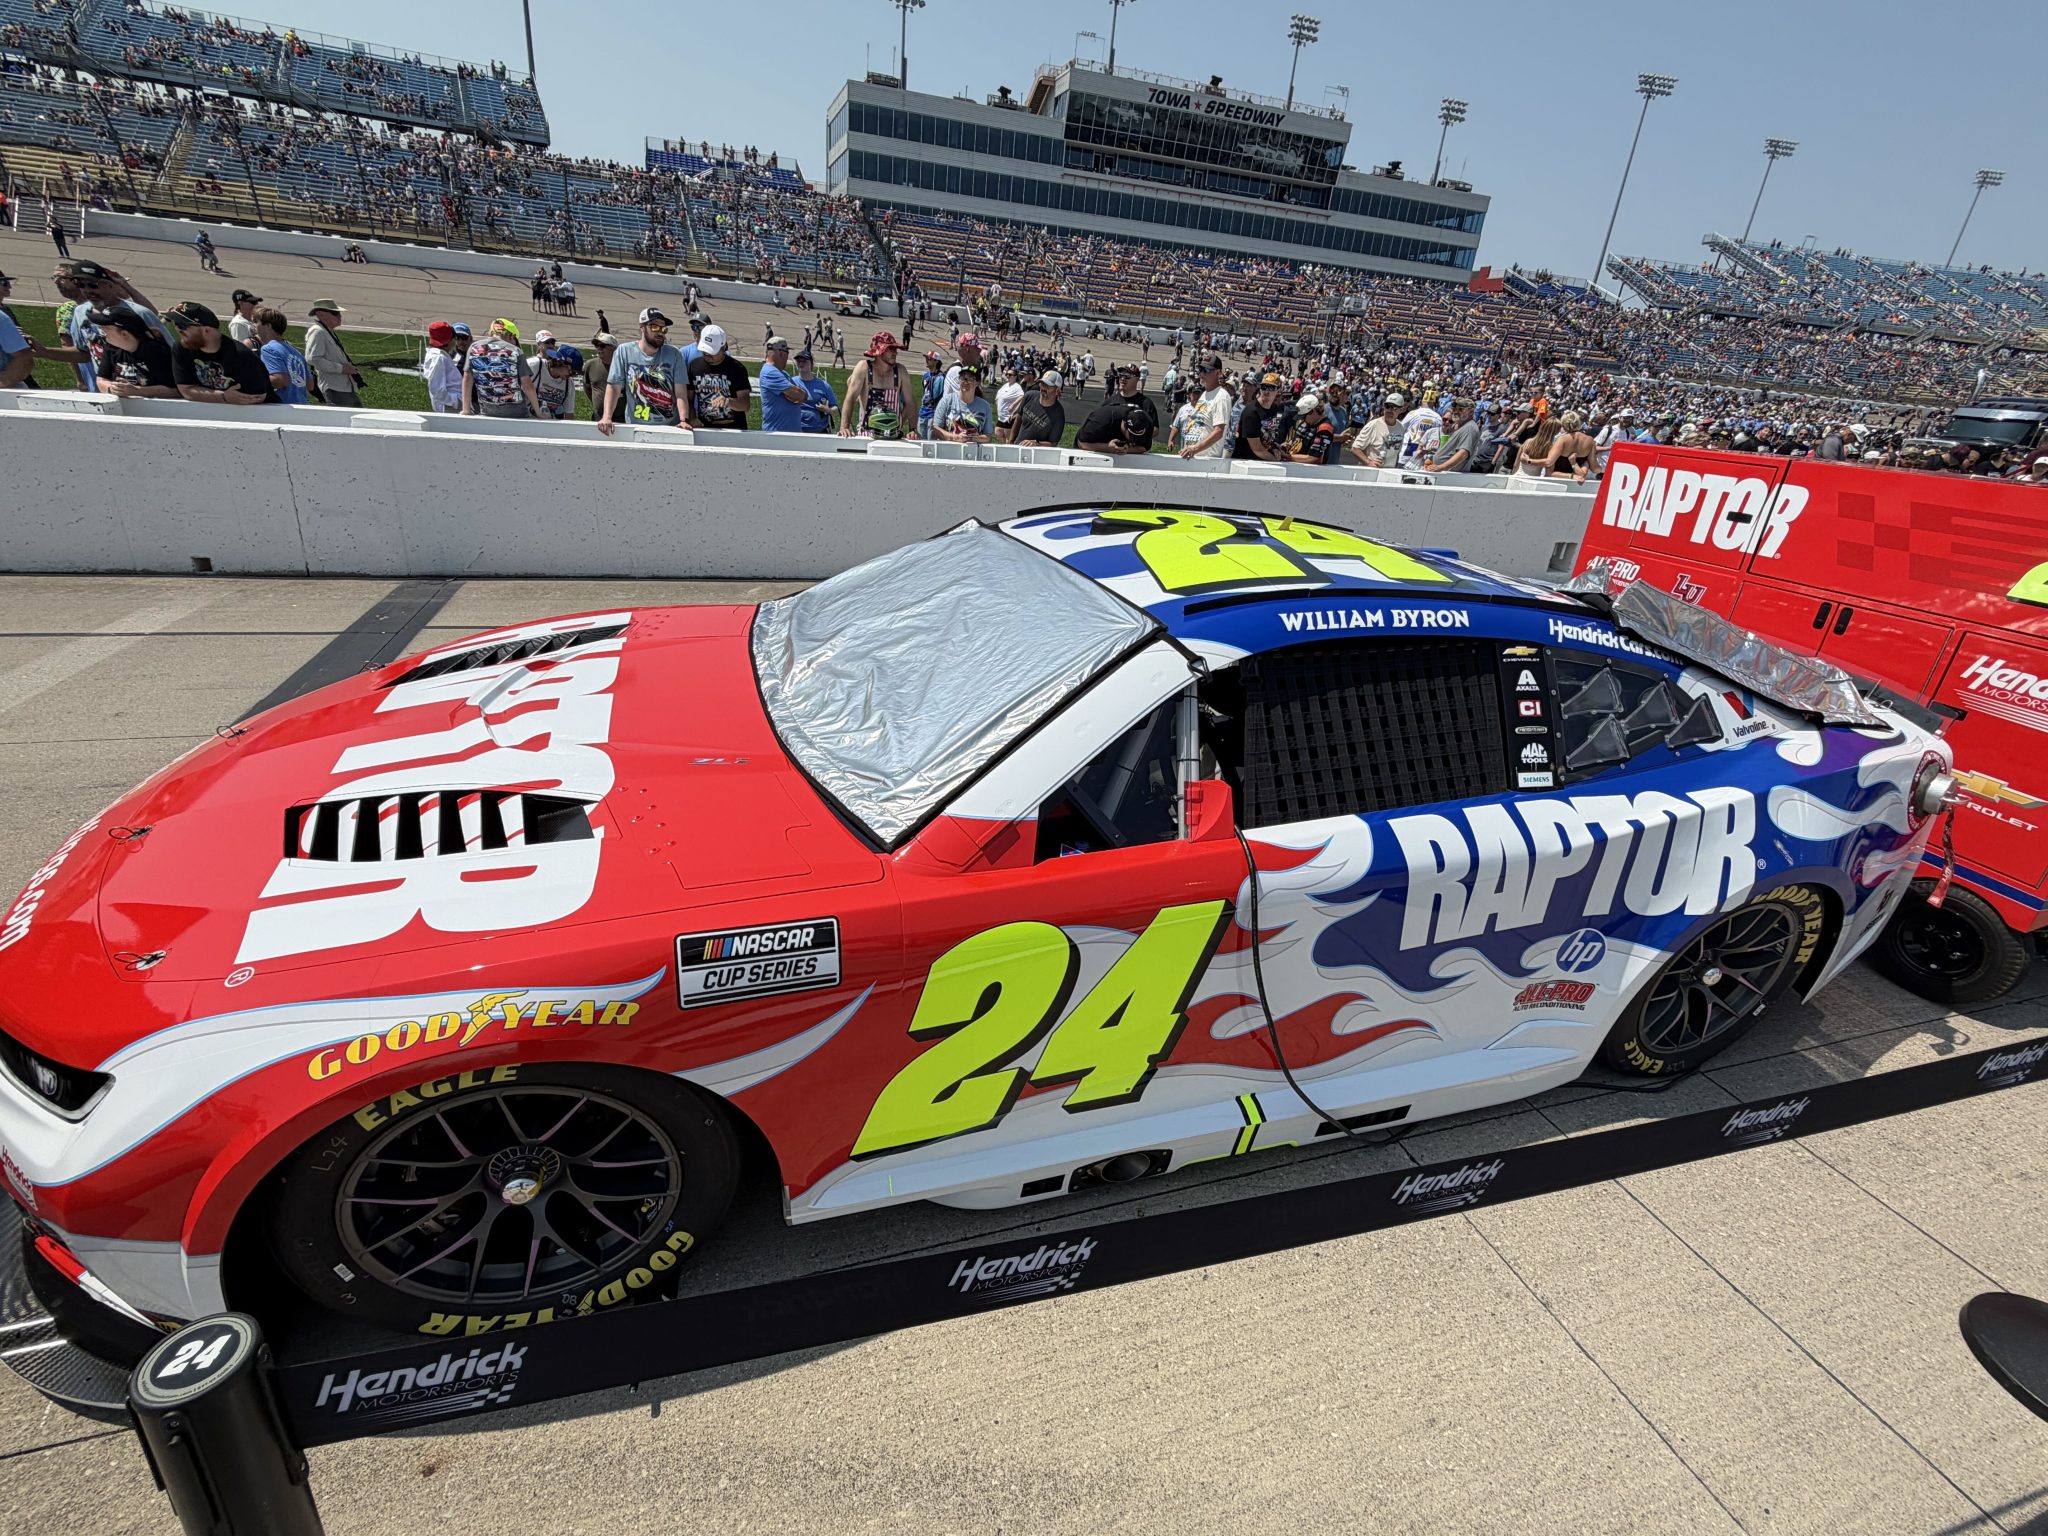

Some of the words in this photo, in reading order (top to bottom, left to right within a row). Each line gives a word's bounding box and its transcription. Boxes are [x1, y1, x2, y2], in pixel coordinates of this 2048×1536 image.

[1149, 88, 1191, 109] IOWA
[1204, 101, 1285, 127] SPEEDWAY
[634, 405, 650, 421] 24
[1602, 462, 1810, 559] RAPTOR
[1279, 608, 1385, 632] WILLIAM
[1392, 609, 1470, 629] BYRON
[1732, 720, 1768, 738] Valvoline
[1521, 742, 1548, 758] MAC
[1522, 775, 1550, 783] SIEMENS
[1966, 801, 2039, 831] ROLET
[1387, 785, 1757, 952] RAPTOR
[730, 927, 815, 957] NASCAR
[1559, 928, 1603, 975] hp
[702, 966, 746, 991] CUP
[747, 956, 818, 984] SERIES
[1512, 1002, 1529, 1012] AUTO
[1529, 1001, 1586, 1011] RECONDITIONING
[850, 898, 1237, 1162] 24
[1623, 1037, 1665, 1074] EAGLE
[353, 1063, 522, 1132] EAGLE
[1720, 1096, 1812, 1138] Hendrick
[1390, 1158, 1506, 1205] Hendrick
[947, 1236, 1099, 1293] Hendrick
[972, 1261, 1087, 1293] MOTORSPORTS
[156, 1333, 232, 1379] 24
[314, 1341, 529, 1414] Hendrick
[355, 1370, 521, 1412] MOTORSPORTS
